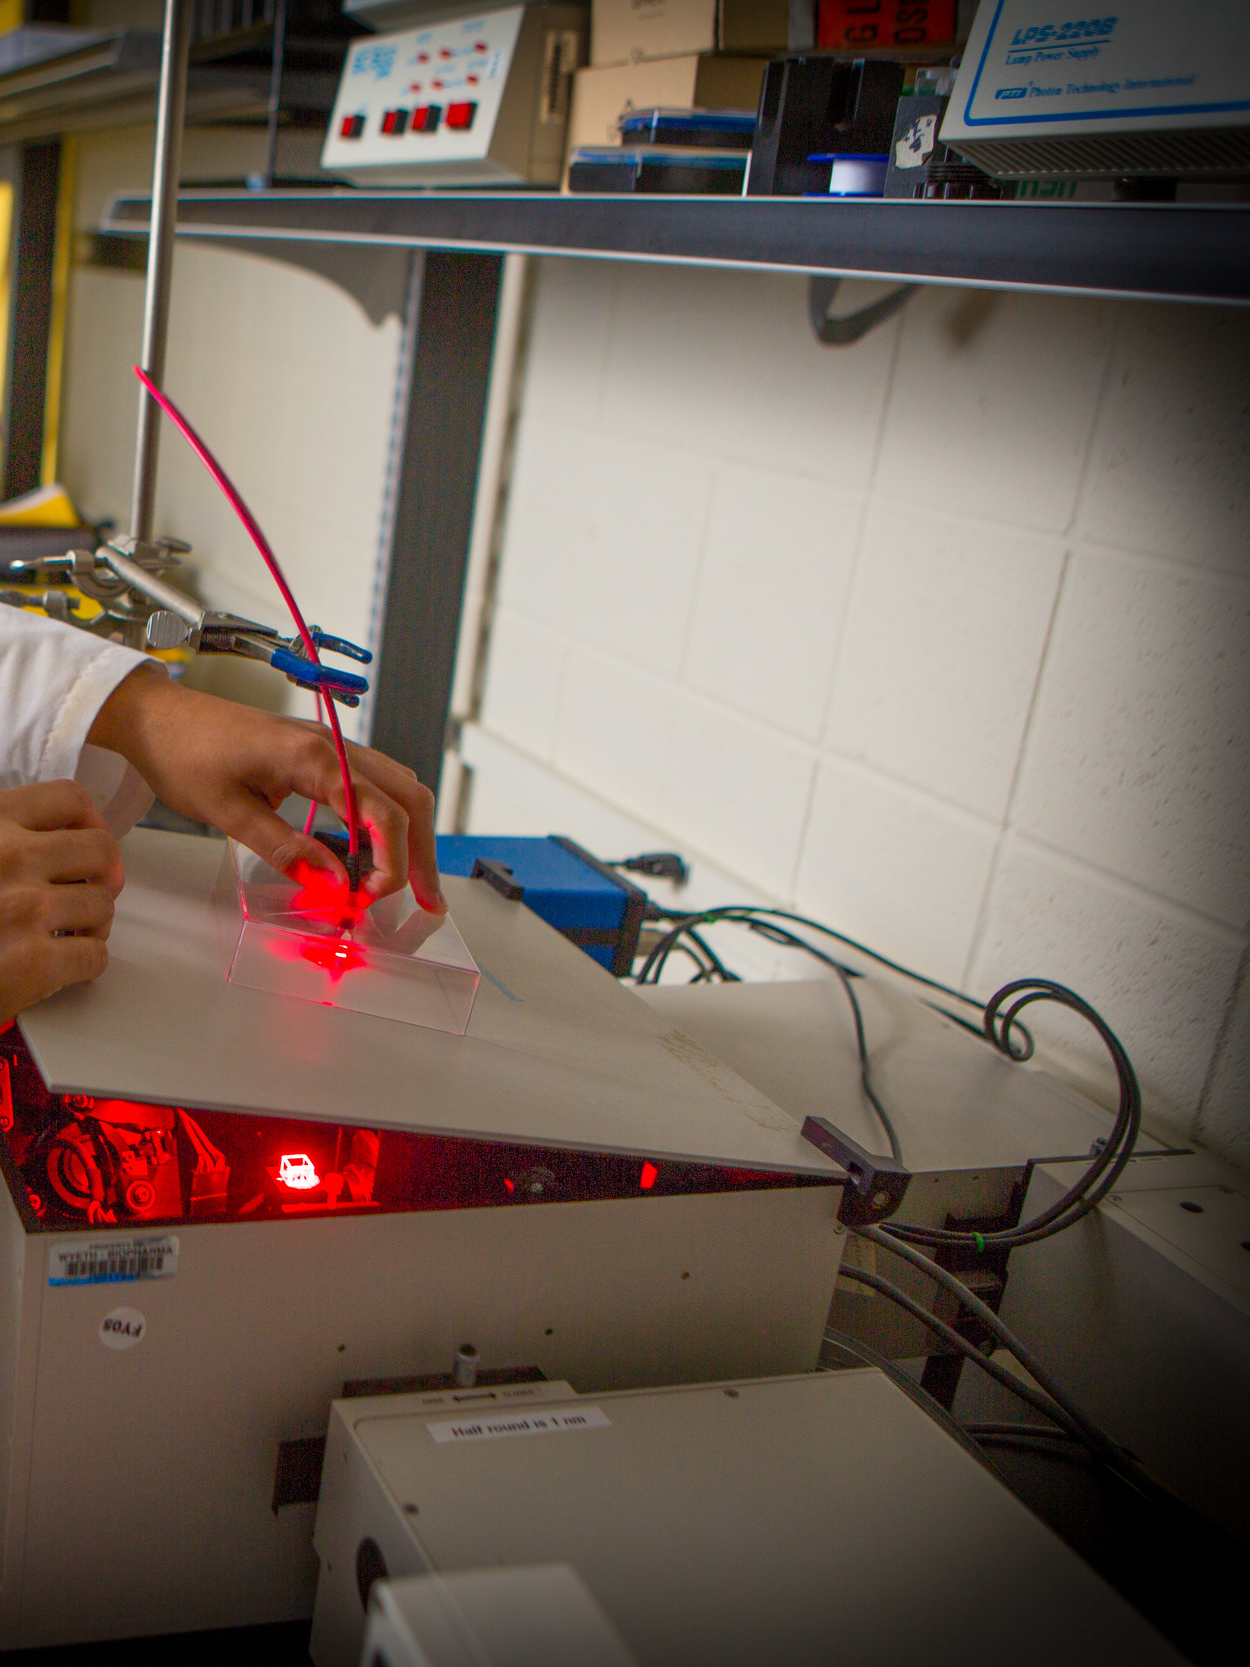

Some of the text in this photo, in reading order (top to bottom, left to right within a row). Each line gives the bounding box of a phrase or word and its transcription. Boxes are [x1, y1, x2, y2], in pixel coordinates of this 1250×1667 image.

[1005, 45, 1100, 67] Lamp Power Supply
[1028, 85, 1063, 98] Photon
[1065, 81, 1121, 95] Technology
[1123, 73, 1197, 90] International
[451, 1414, 587, 1438] Half round is 1 nm
